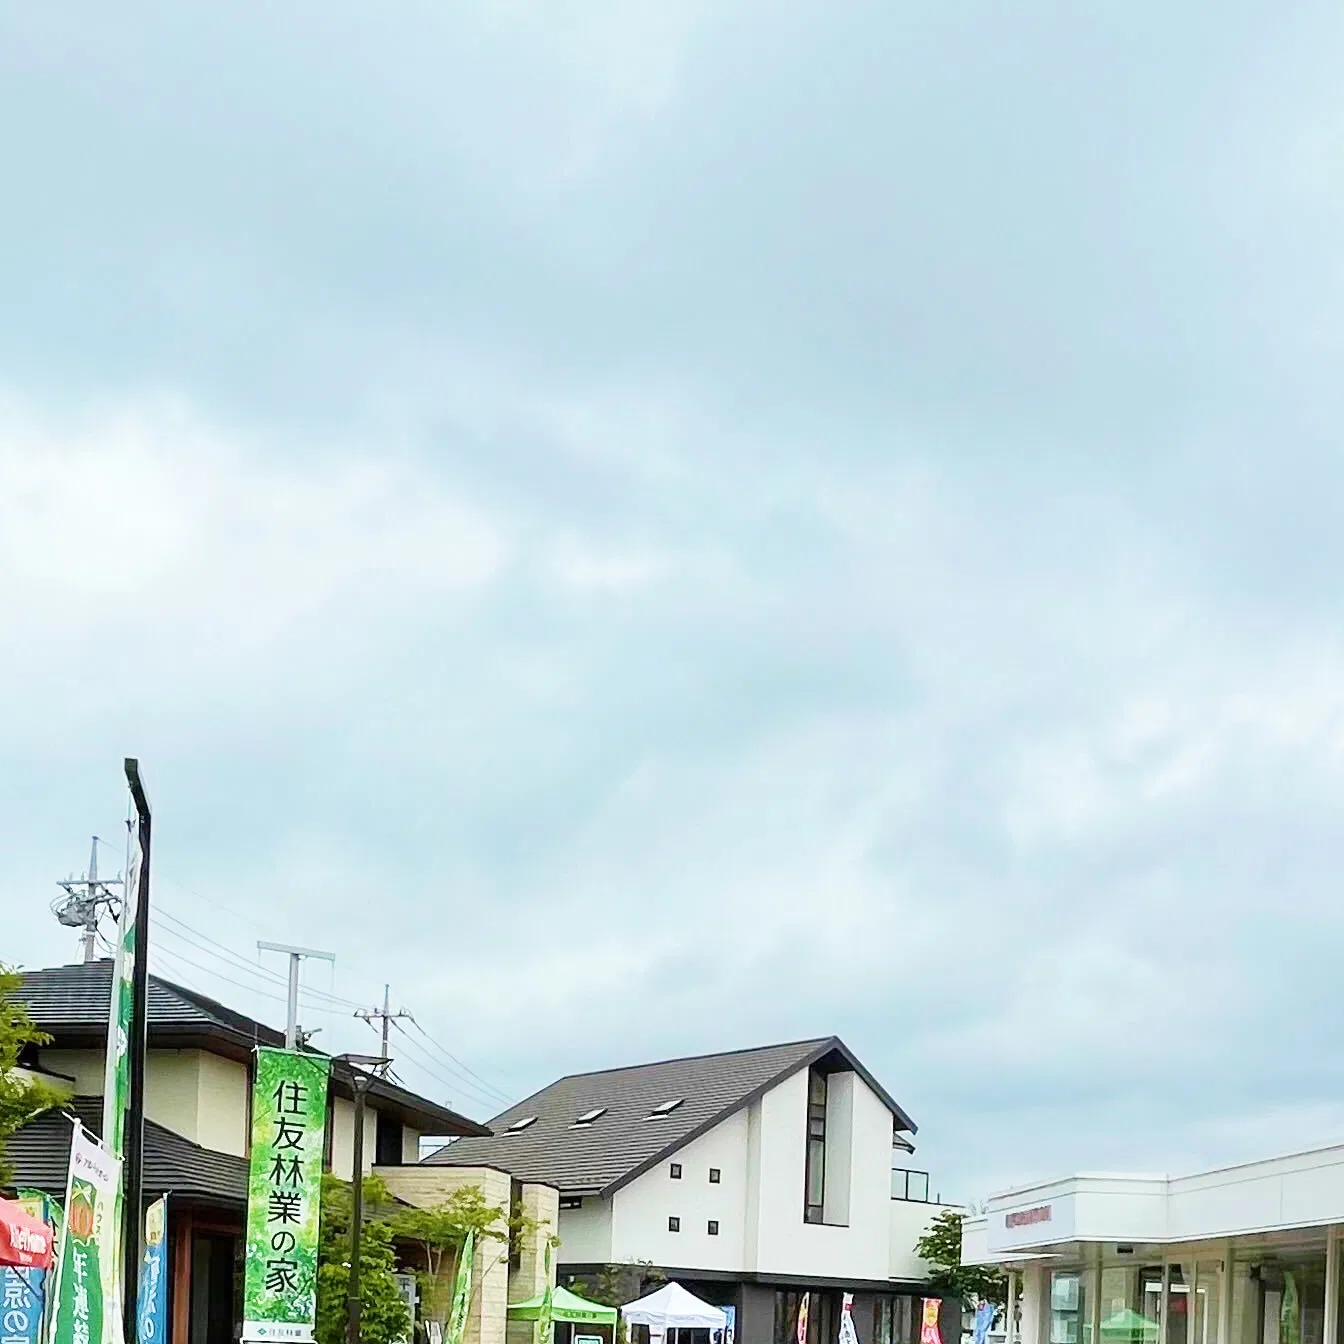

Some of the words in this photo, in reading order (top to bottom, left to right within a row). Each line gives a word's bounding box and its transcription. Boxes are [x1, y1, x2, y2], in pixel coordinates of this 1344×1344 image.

[265, 1079, 308, 1293] 住友林業の家
